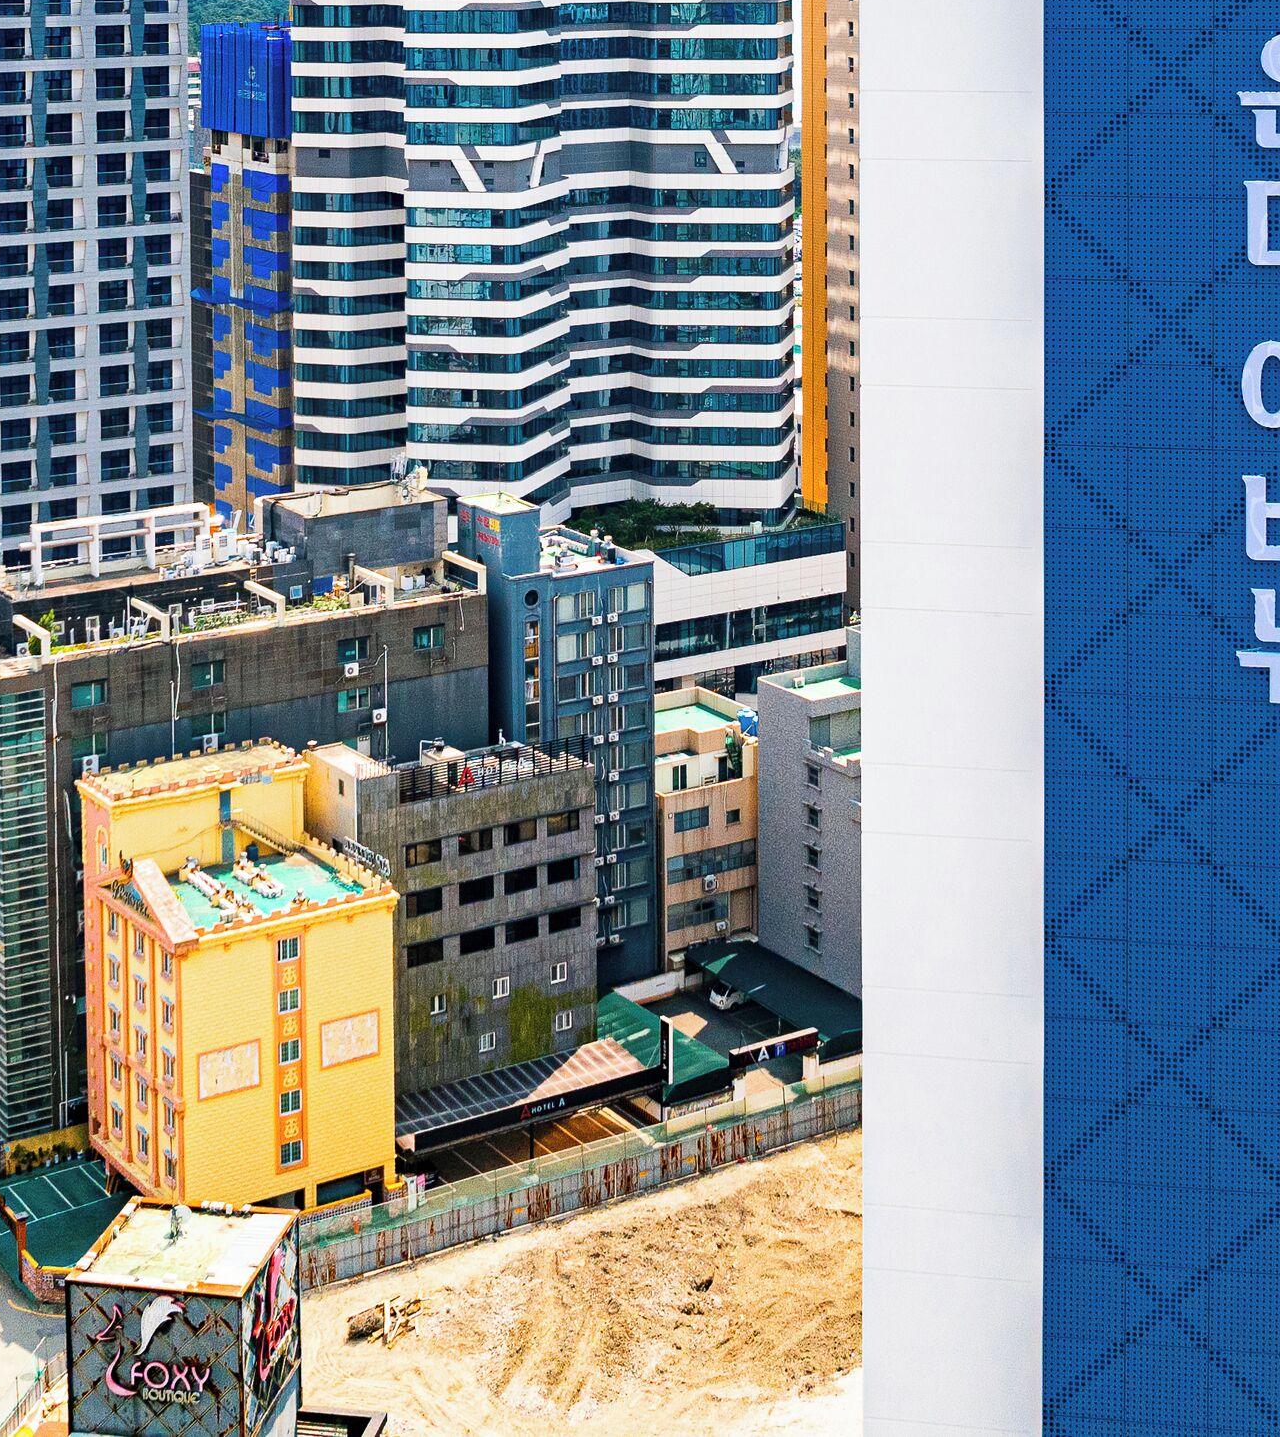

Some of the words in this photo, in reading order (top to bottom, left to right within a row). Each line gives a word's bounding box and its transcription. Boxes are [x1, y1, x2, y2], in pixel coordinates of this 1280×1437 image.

[531, 1102, 556, 1114] HOTEL
[130, 1361, 212, 1393] FOXY
[142, 1387, 201, 1404] BOUTIQUE
